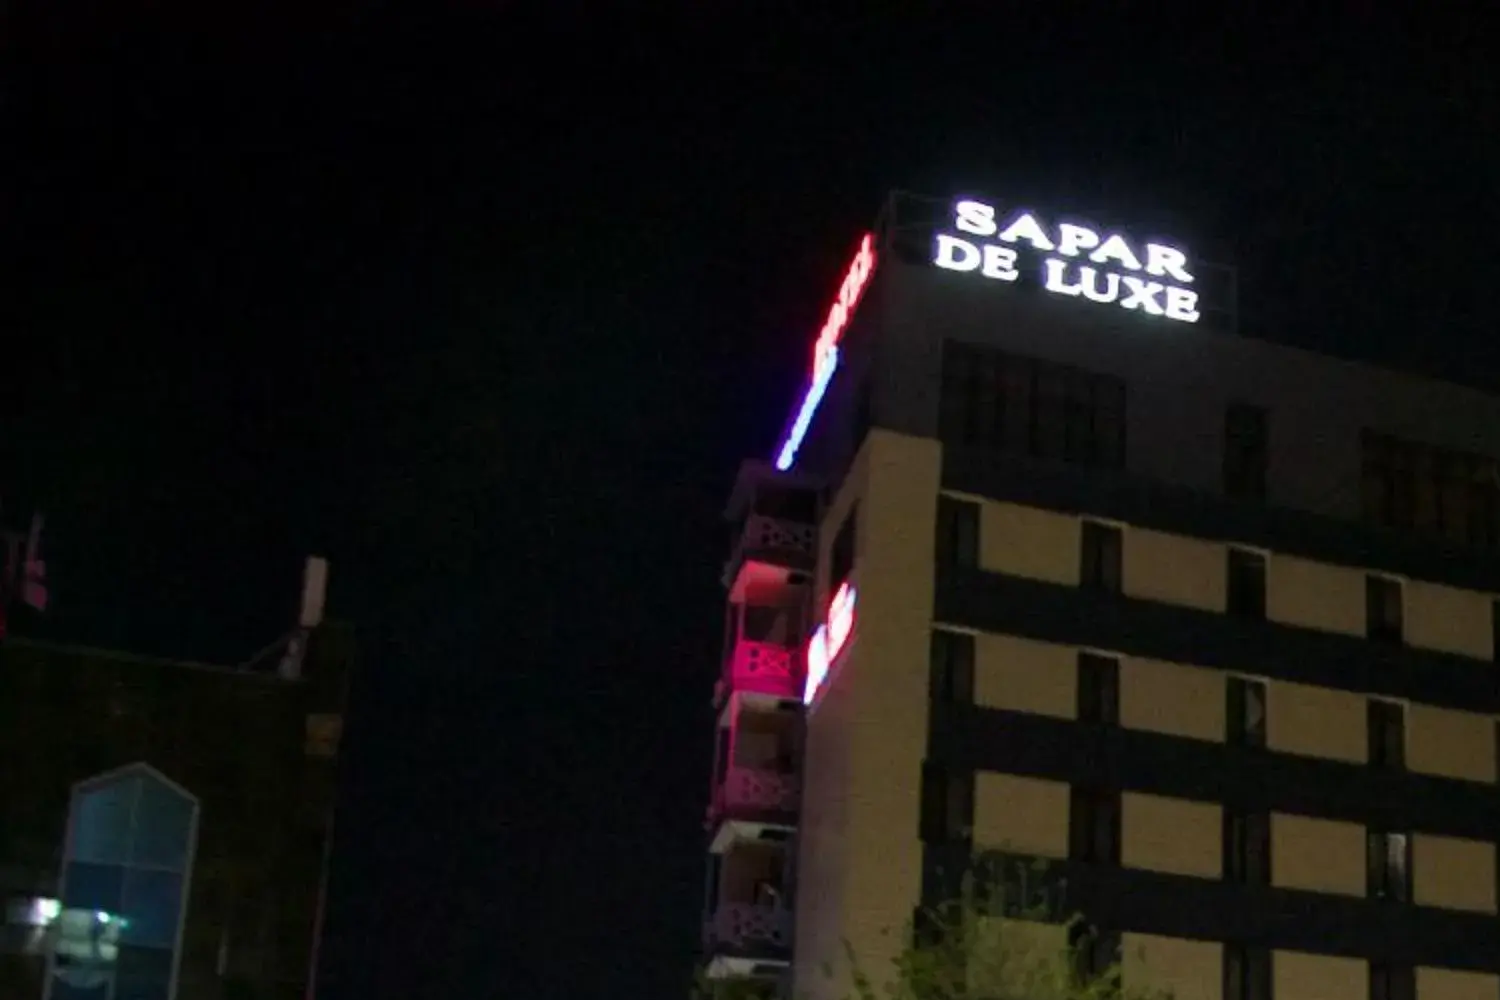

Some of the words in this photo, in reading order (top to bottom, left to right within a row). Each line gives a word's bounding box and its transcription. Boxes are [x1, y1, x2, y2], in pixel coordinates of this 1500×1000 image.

[935, 234, 1019, 281] DE
[1045, 257, 1200, 323] LUXE
[955, 200, 1195, 283] SAPAR
